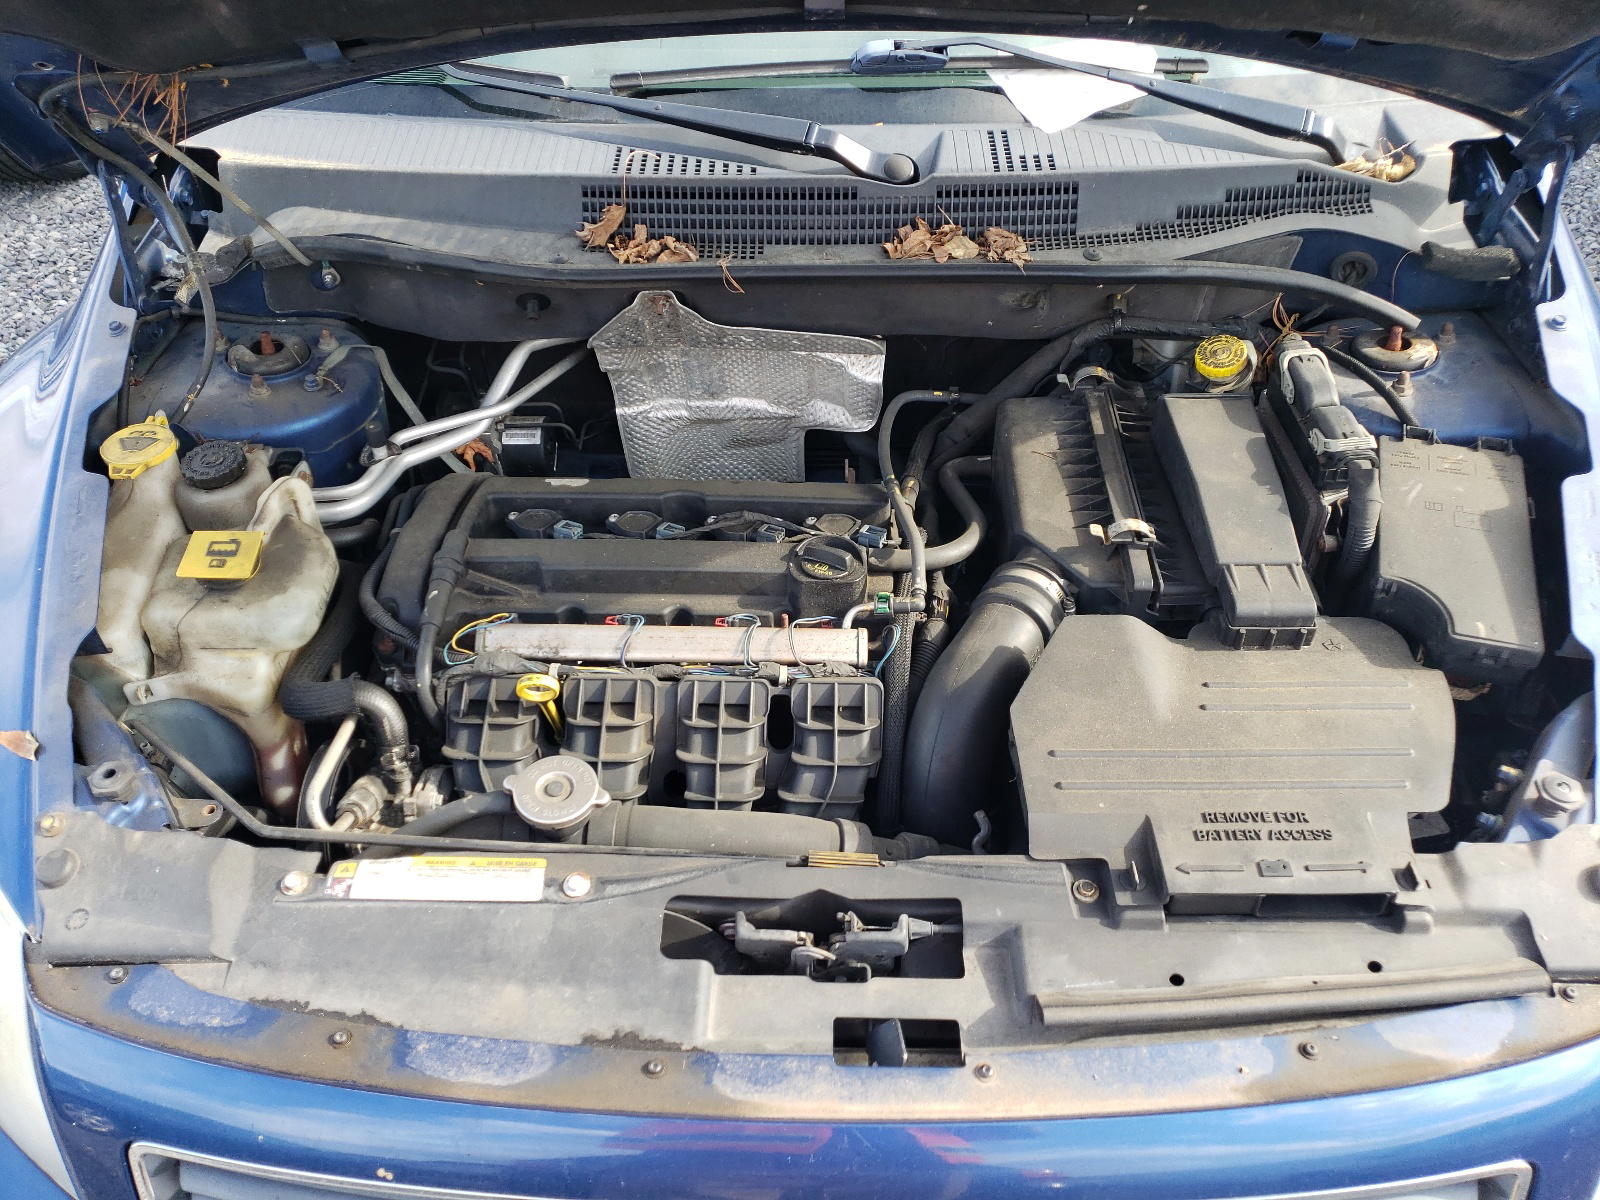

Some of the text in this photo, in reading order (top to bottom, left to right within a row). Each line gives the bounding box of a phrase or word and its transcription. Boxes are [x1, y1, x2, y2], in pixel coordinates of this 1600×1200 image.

[1201, 811, 1310, 823] REMOVE FOR
[1192, 829, 1333, 841] BATTERY ACCESS
